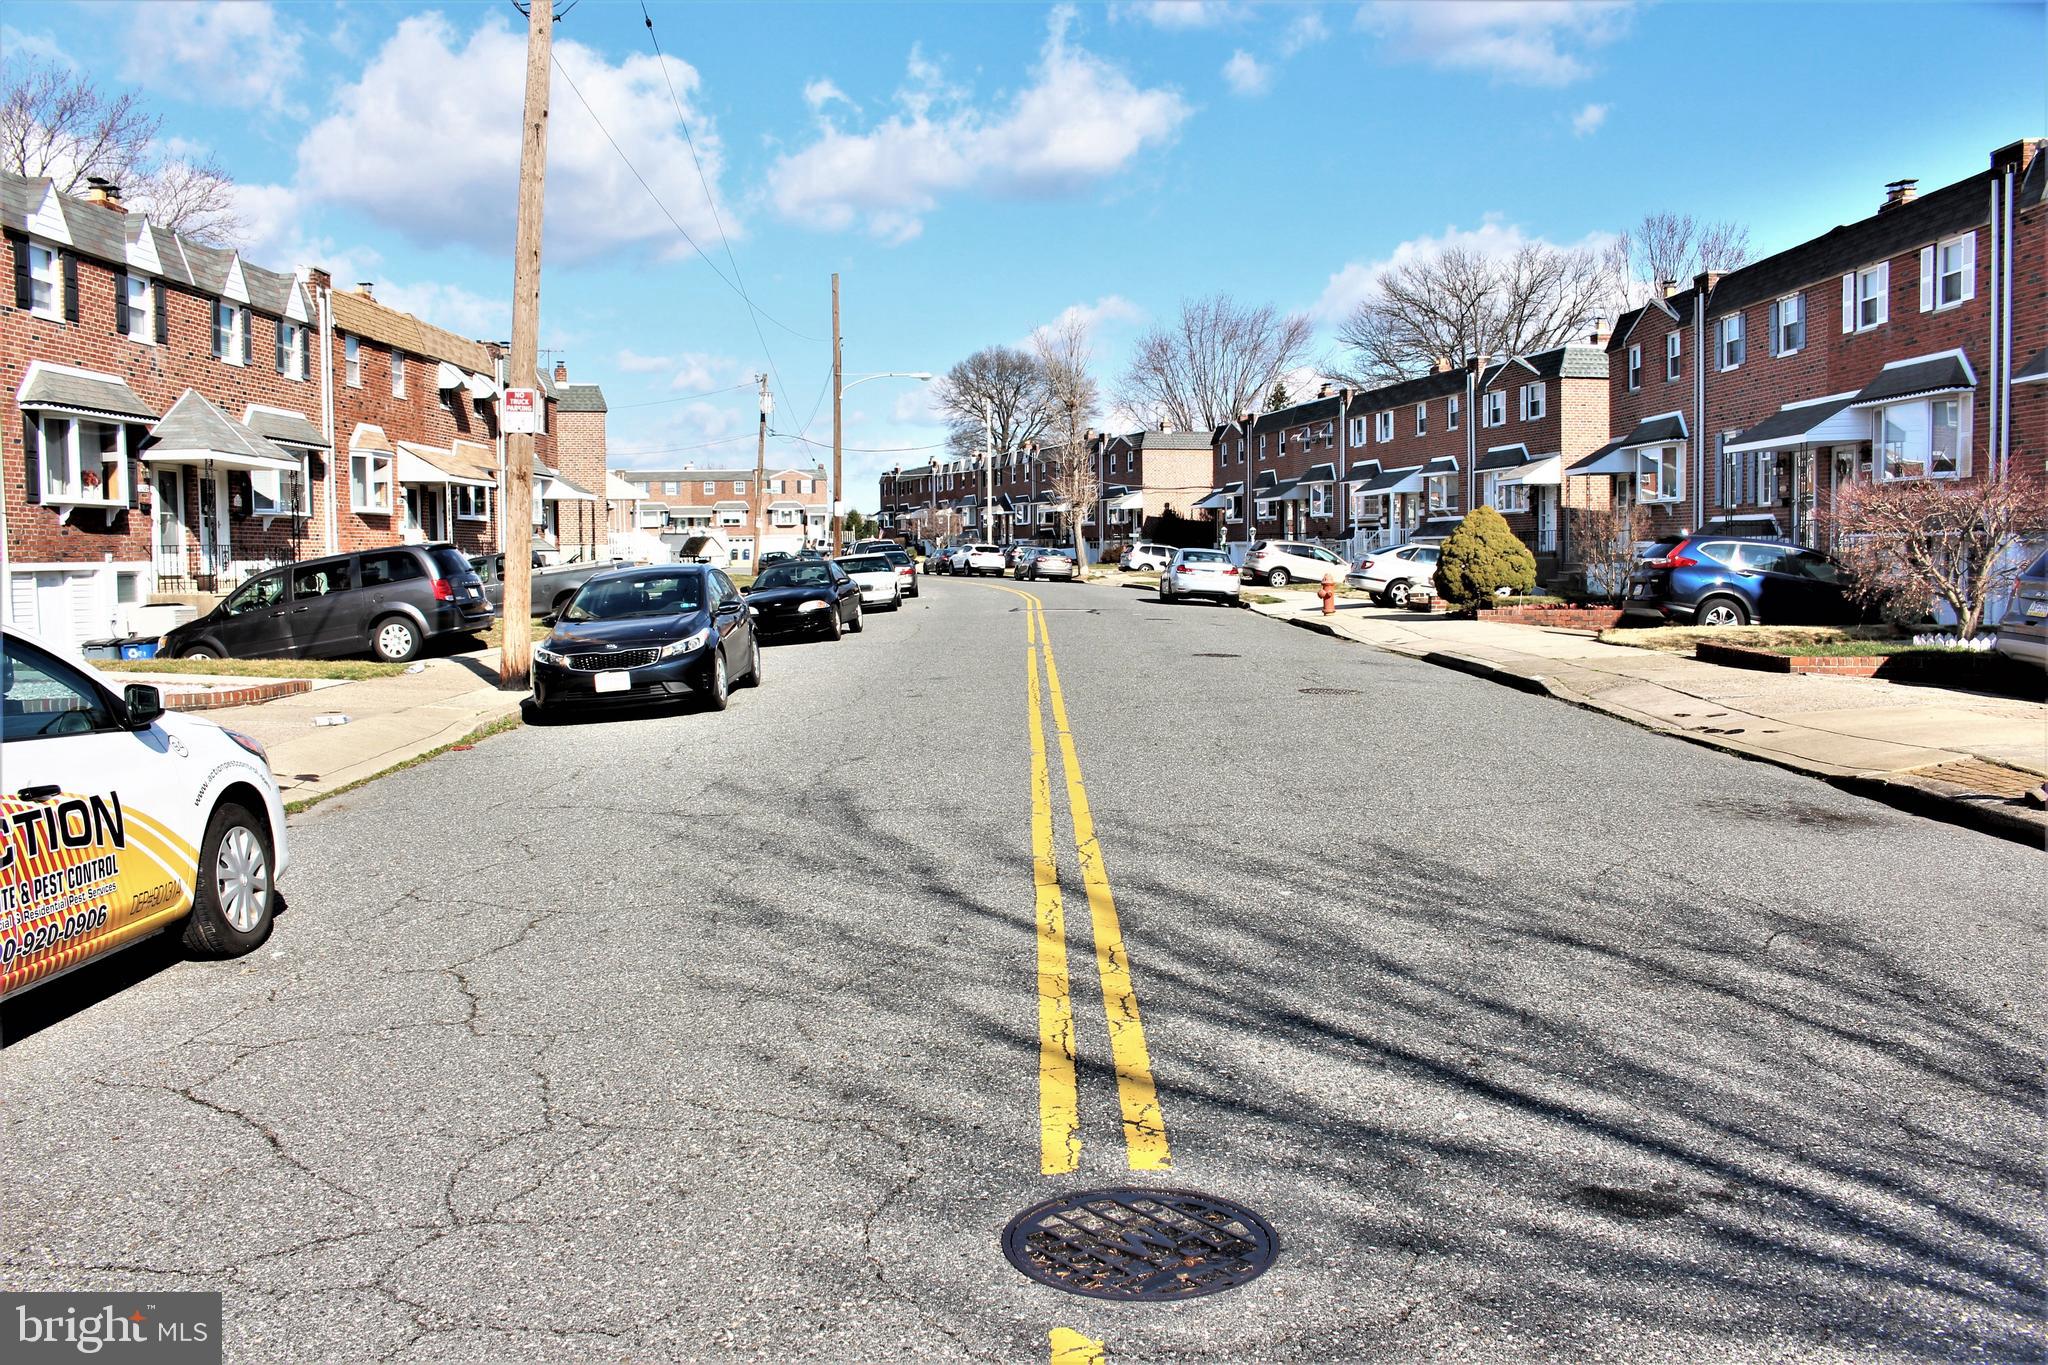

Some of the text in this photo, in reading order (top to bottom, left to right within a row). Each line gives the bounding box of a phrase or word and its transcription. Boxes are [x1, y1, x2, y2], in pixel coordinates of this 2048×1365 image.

[21, 882, 30, 905] &
[34, 871, 63, 901] PEST
[67, 854, 119, 889] CONTROL
[24, 897, 68, 922] Residential
[69, 893, 85, 906] Pest
[87, 882, 117, 899] Services
[0, 904, 108, 963] 0-920-0906
